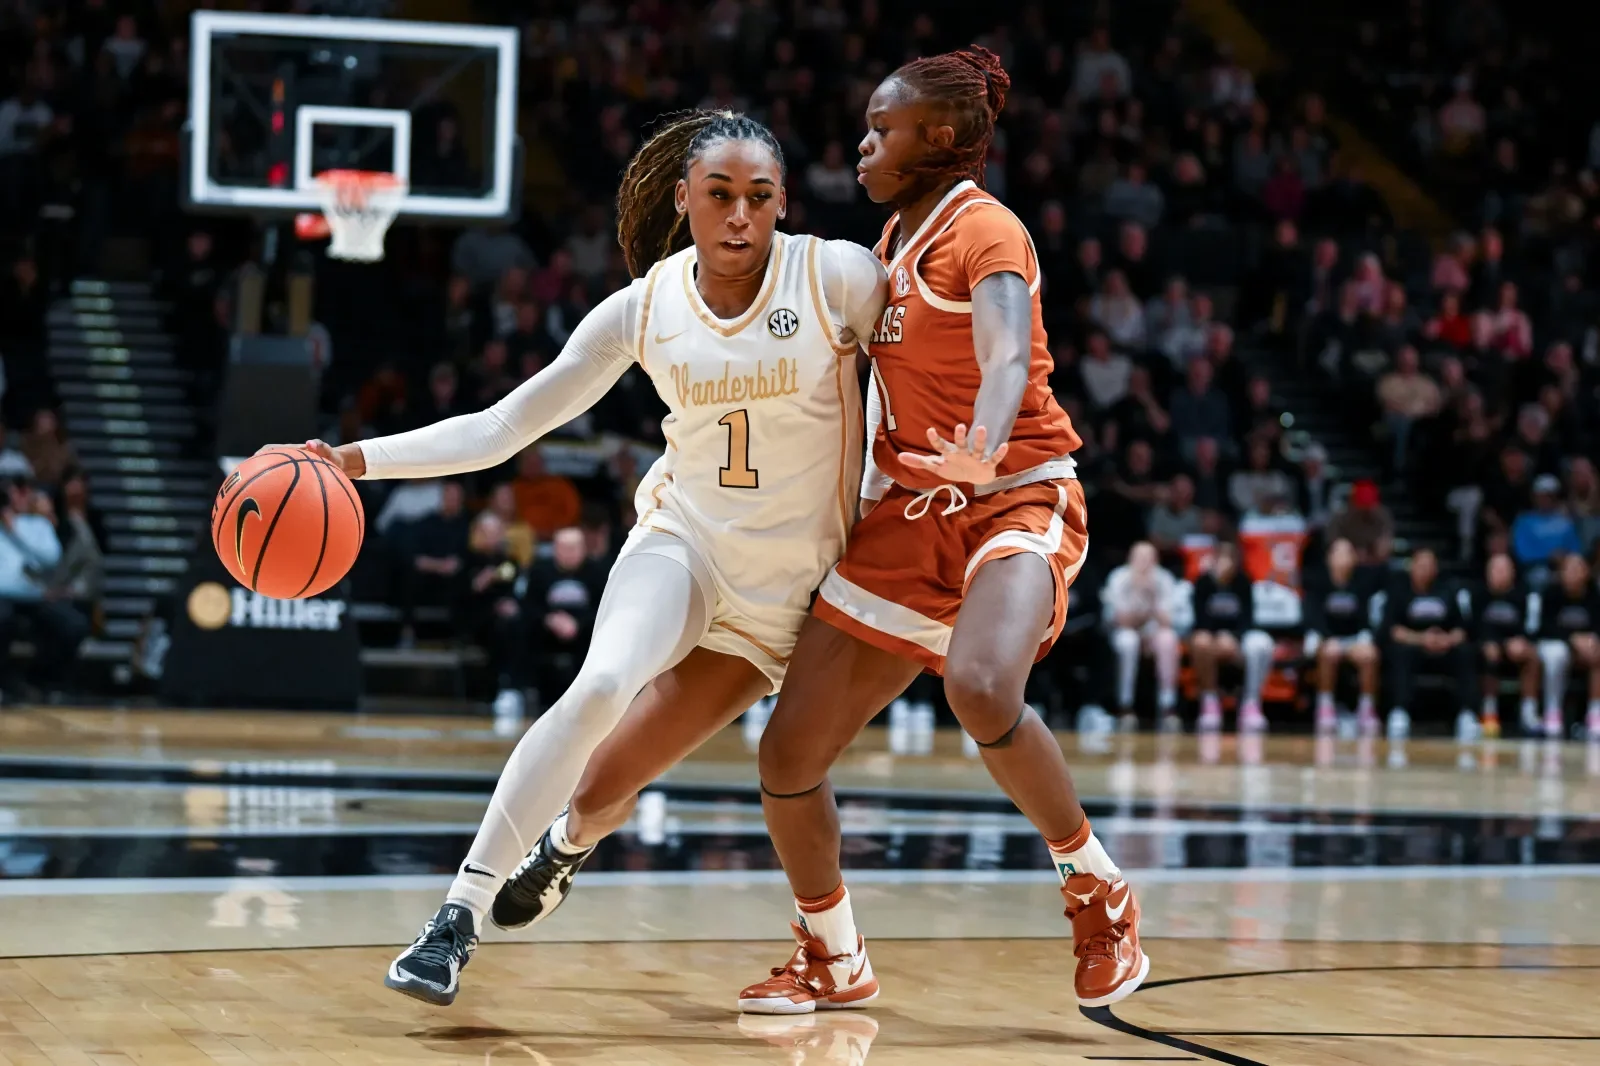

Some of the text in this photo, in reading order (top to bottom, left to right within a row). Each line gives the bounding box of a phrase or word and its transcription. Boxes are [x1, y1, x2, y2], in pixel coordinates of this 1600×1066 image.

[769, 309, 798, 338] SEC
[670, 357, 799, 408] Vanderbilt
[718, 408, 758, 488] 1
